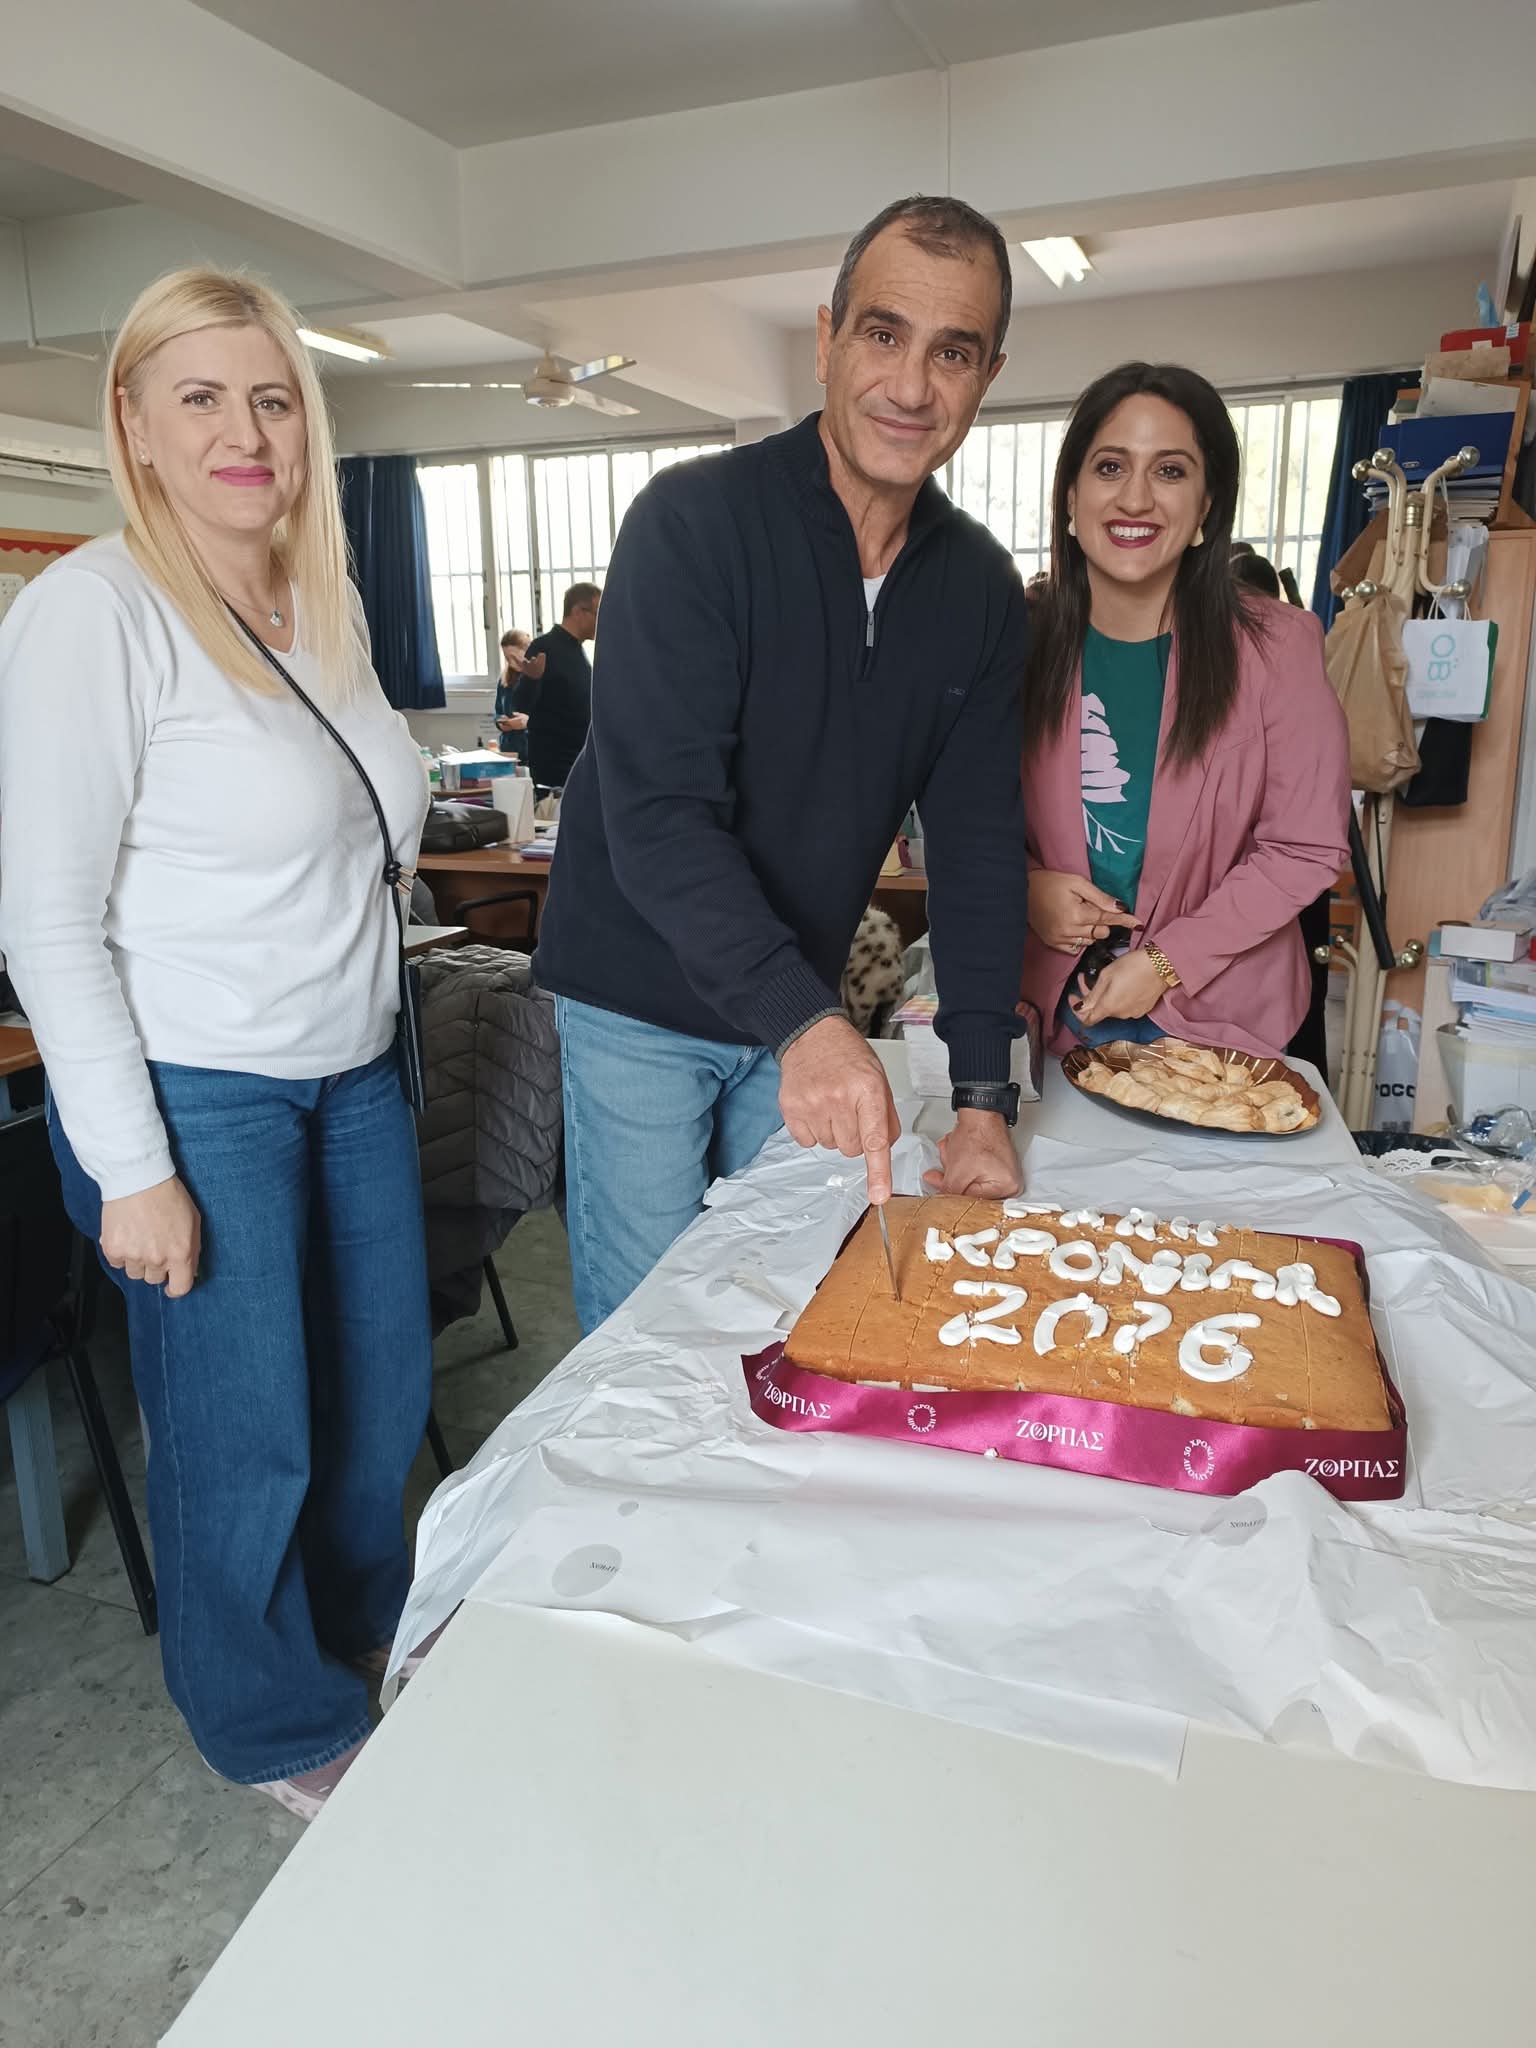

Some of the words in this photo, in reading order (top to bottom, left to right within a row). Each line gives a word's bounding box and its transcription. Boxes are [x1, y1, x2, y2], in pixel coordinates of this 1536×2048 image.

[938, 1279, 1262, 1383] 2026
[764, 1381, 832, 1420] ΖΟΡΠΑΣ
[1016, 1418, 1104, 1452] ΖΟΡΠΑΣ
[1183, 1446, 1192, 1457] 50
[1304, 1457, 1400, 1480] ΖΟΡΠΑΣ
